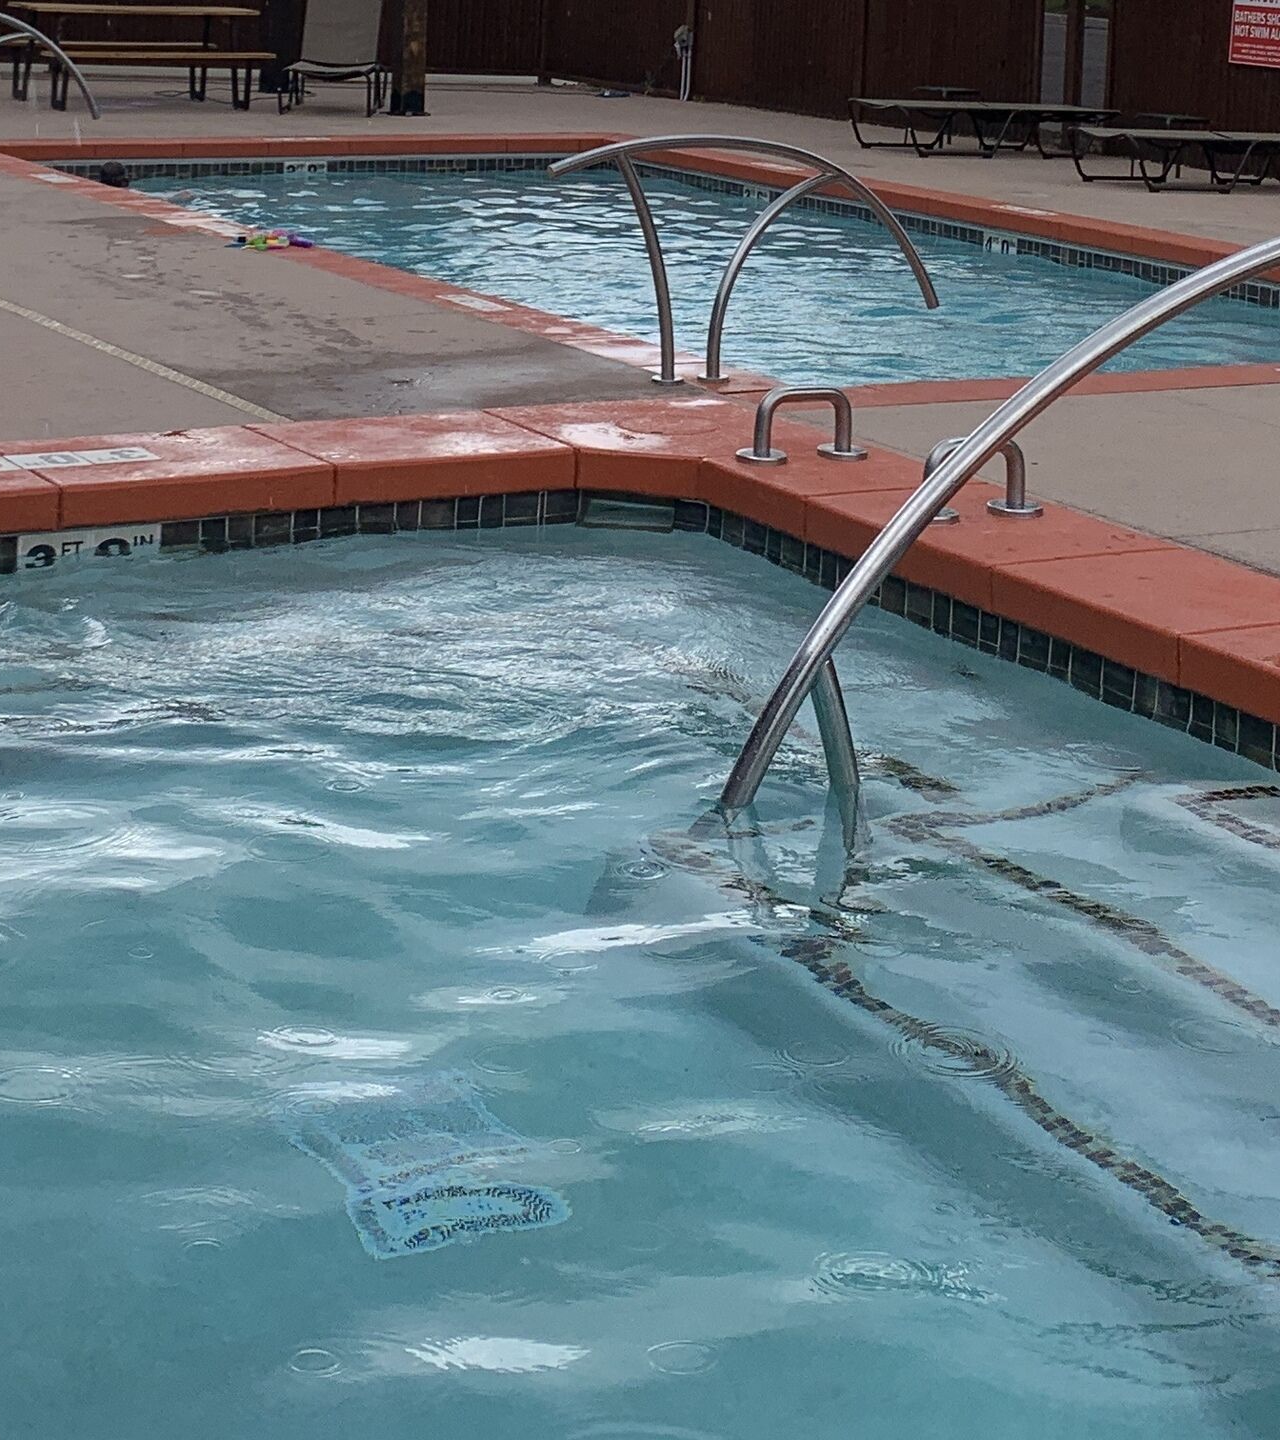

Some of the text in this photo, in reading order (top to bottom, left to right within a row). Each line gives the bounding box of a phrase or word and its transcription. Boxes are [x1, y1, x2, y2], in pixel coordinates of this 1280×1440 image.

[1234, 10, 1266, 24] BATHERS
[1234, 25, 1250, 37] NOT
[1250, 26, 1270, 39] SWIM
[25, 544, 57, 568] 3
[61, 541, 84, 557] FT
[133, 534, 154, 546] IN
